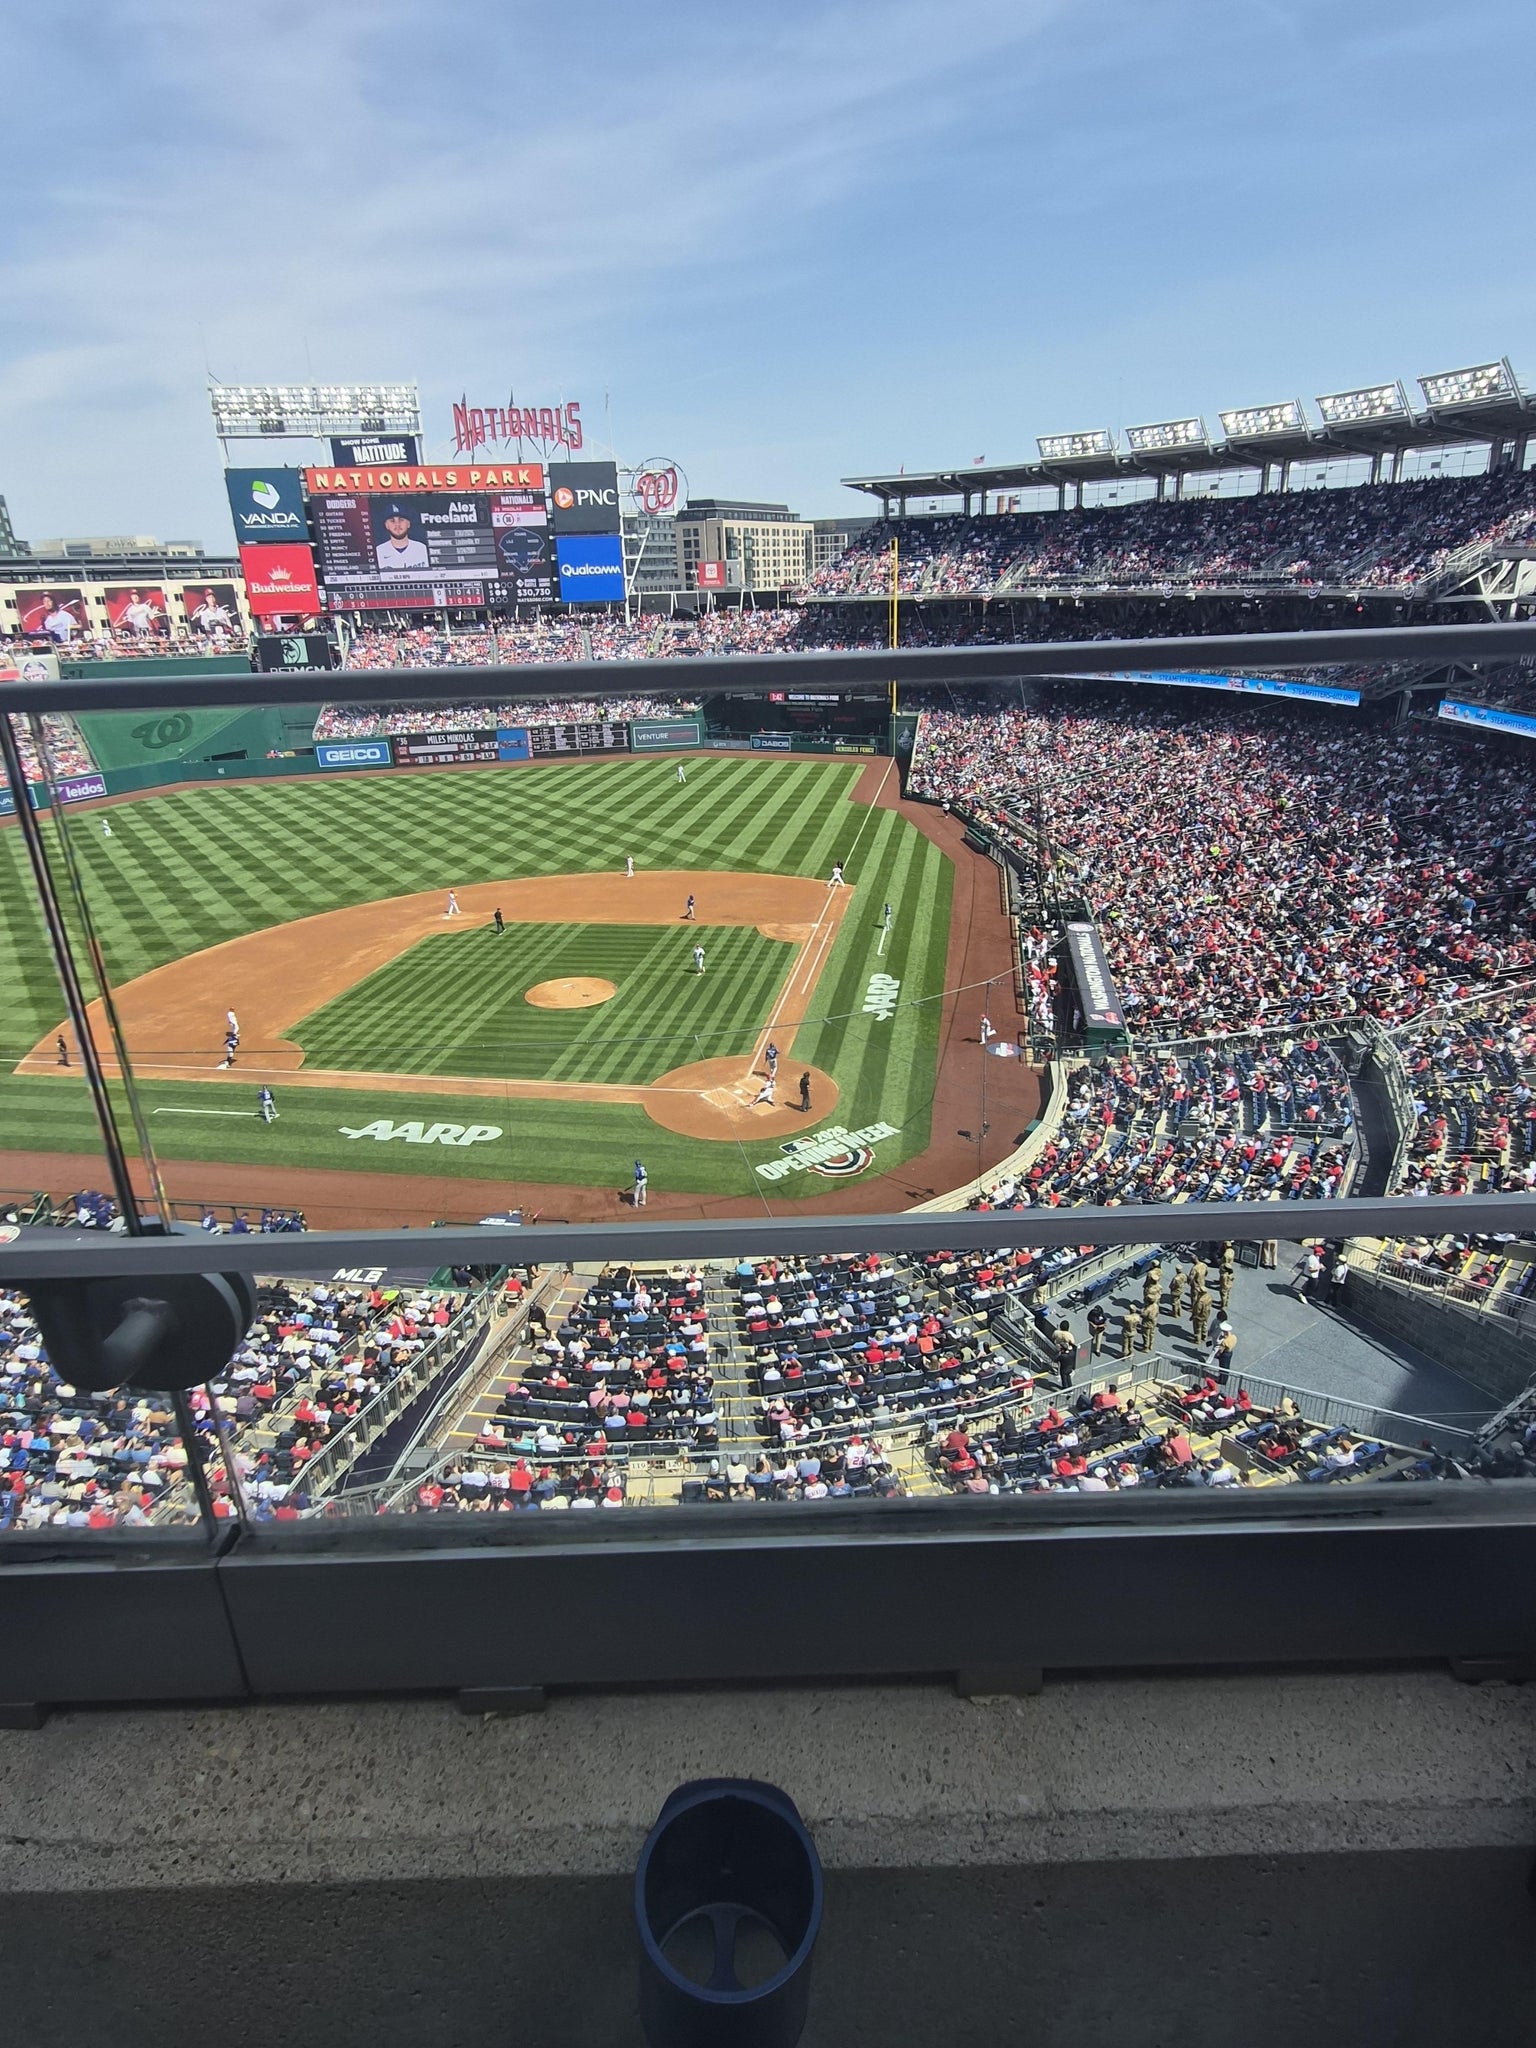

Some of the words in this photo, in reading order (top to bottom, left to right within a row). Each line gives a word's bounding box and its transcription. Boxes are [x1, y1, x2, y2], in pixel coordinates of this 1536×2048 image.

[453, 402, 583, 451] NATIONALS
[353, 443, 407, 463] NATITUDE
[315, 471, 458, 489] NATIONALS
[470, 469, 531, 486] PARK
[575, 489, 616, 506] PNC
[448, 502, 476, 513] Alex
[239, 512, 301, 525] VANDA
[420, 512, 477, 524] Freeland
[561, 563, 621, 577] Qualcomm
[250, 582, 312, 594] Budweiser
[517, 589, 551, 597] $30,730
[427, 734, 447, 744] MILES
[447, 733, 475, 743] MIKOLAS
[637, 732, 669, 741] VENTURE
[326, 748, 381, 762] GEICO
[65, 783, 104, 798] leidos
[862, 973, 900, 1022] AARP
[338, 1119, 503, 1146] AARP
[812, 1125, 849, 1144] 2026
[755, 1140, 850, 1180] OPENING
[838, 1121, 901, 1149] WEEK
[332, 1267, 385, 1283] MLB
[607, 1477, 621, 1487] 40
